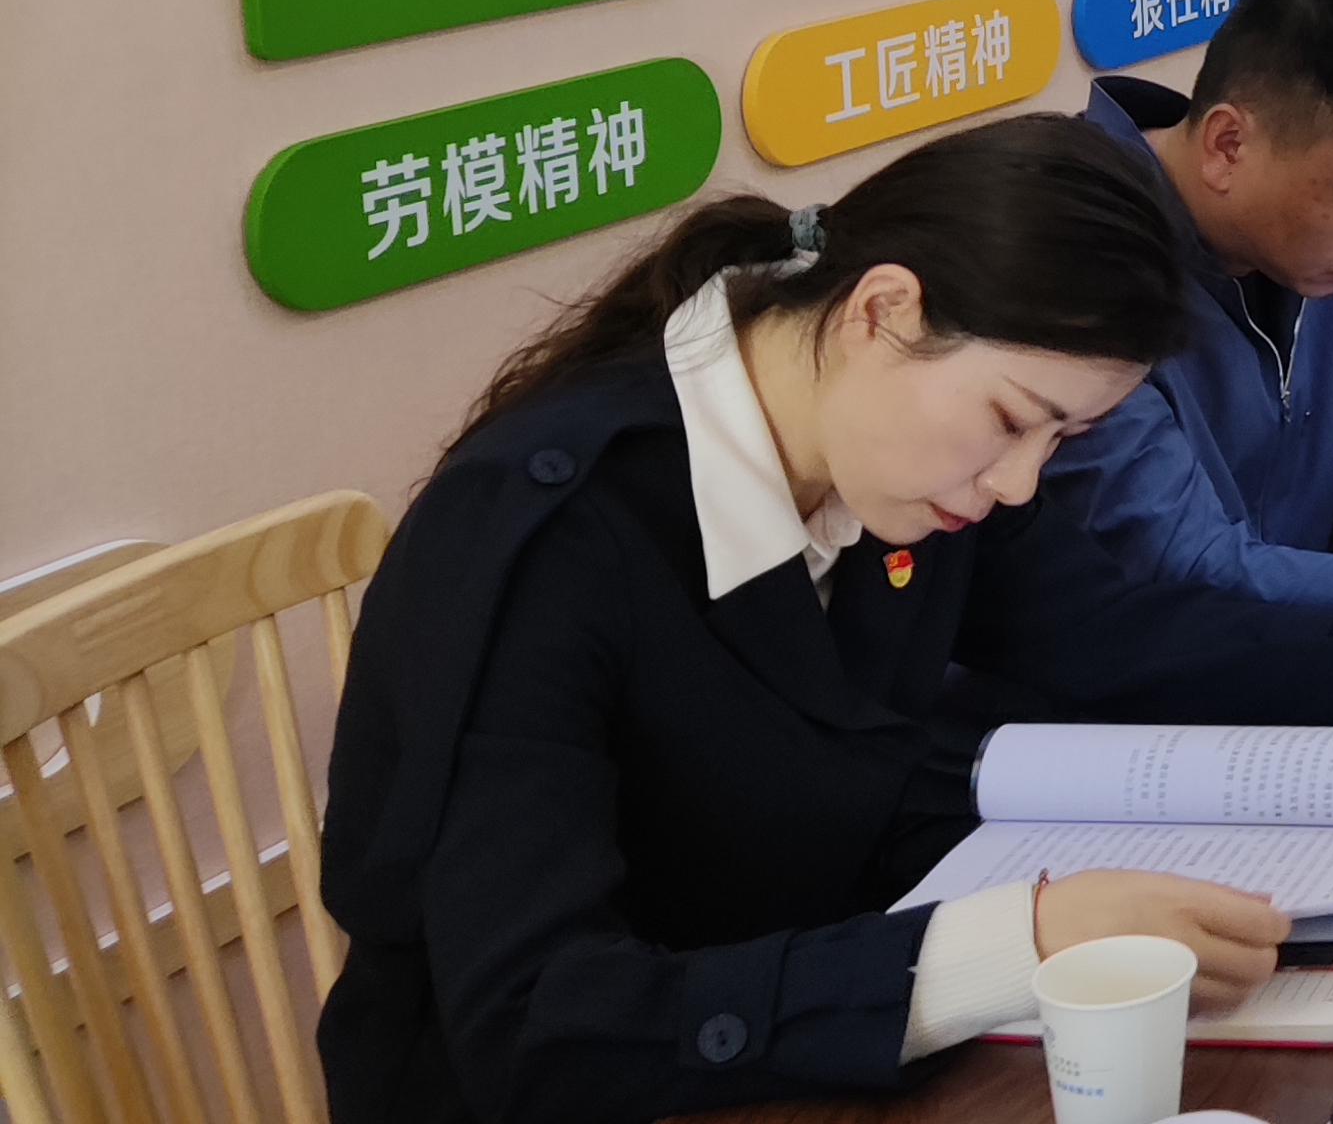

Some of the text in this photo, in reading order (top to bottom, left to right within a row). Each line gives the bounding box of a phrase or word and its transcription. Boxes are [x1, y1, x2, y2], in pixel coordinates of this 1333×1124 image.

[824, 9, 1012, 123] 工匠精神
[361, 100, 647, 261] 劳模精神
